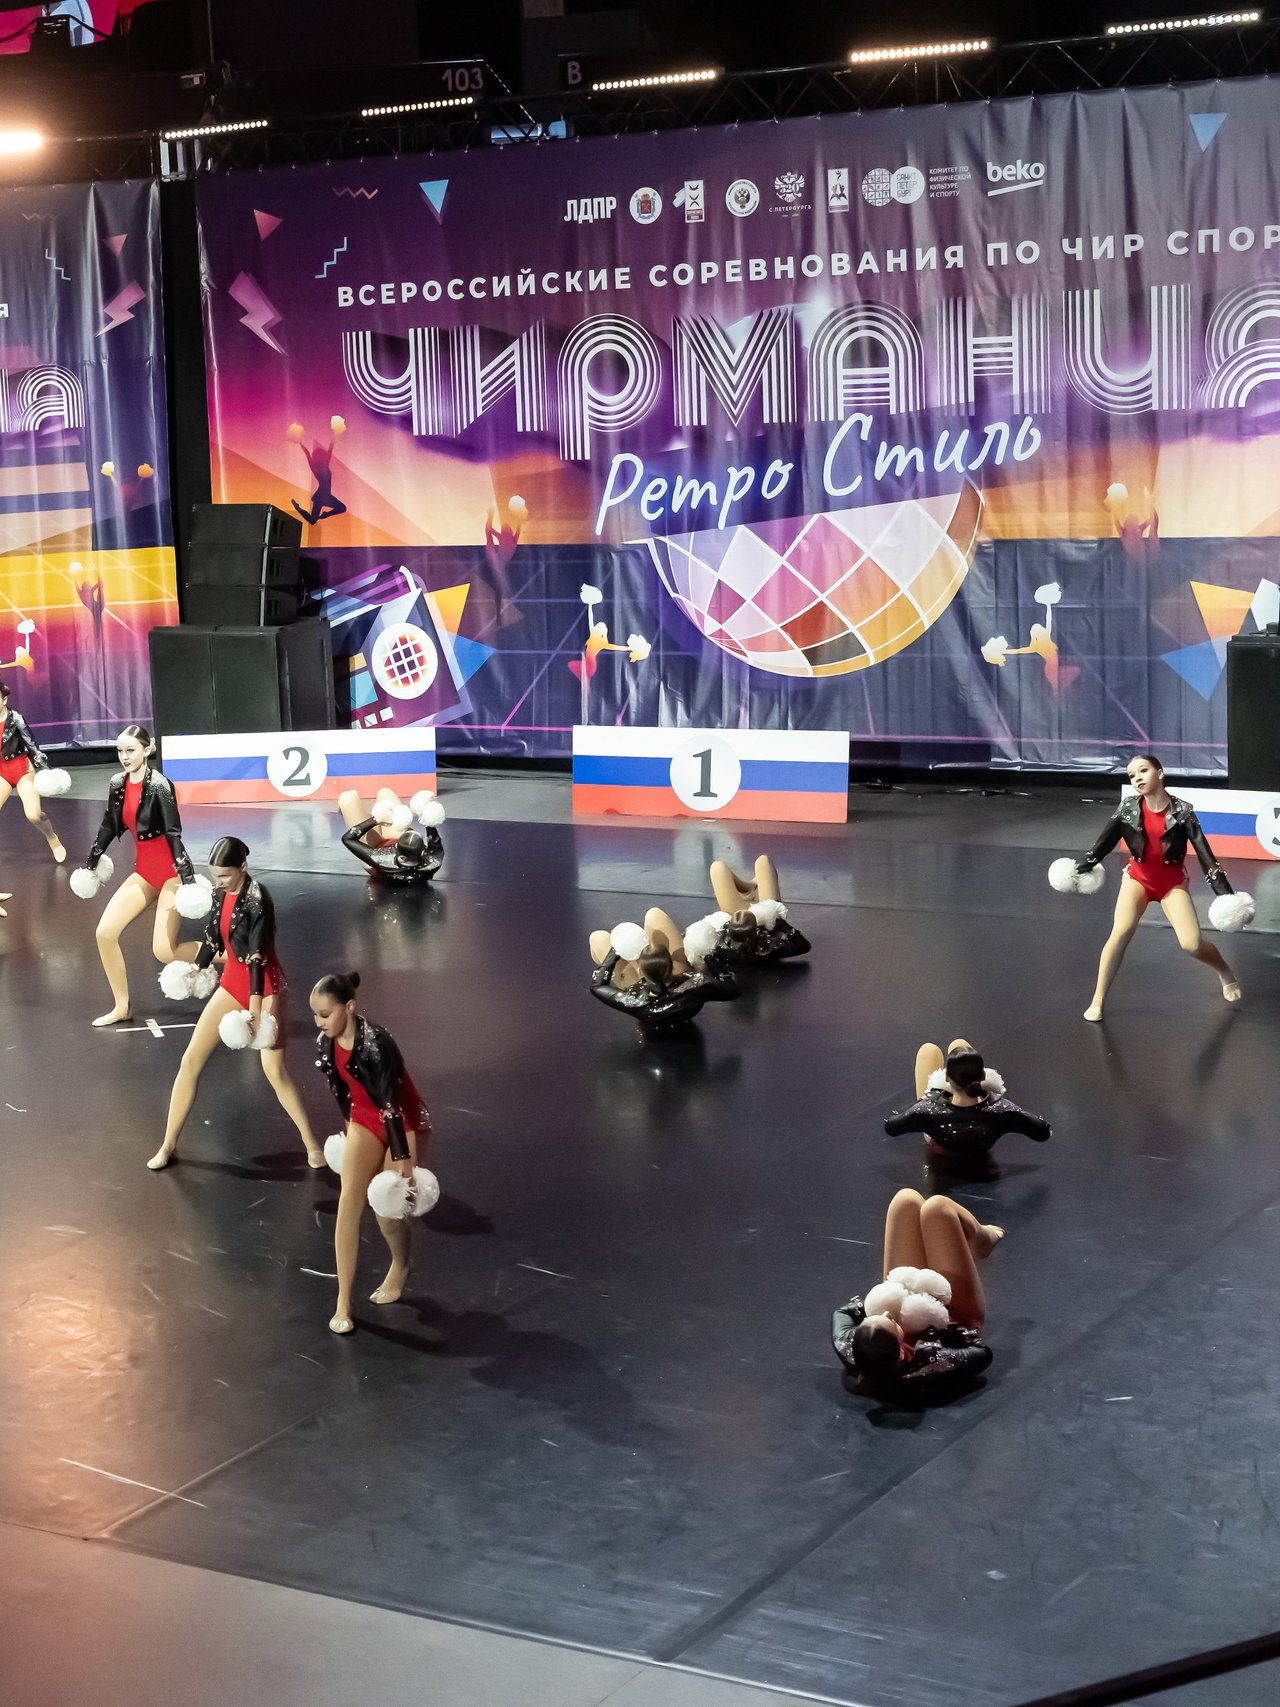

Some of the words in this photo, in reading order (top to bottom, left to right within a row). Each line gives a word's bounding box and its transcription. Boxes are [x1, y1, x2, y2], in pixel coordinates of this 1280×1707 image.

[441, 67, 484, 92] 103
[567, 61, 582, 85] B
[929, 167, 957, 175] КОМИТЕТ
[929, 173, 971, 182] ФИЗИЧЕСКОЙ
[987, 160, 1045, 182] beko
[564, 197, 617, 224] ЛДПР
[336, 263, 631, 308] ВСЕРОССИЙСКИЕ
[648, 245, 964, 288] СОРЕВНОВАНИЯ
[986, 240, 1040, 266] ПО
[1062, 234, 1145, 261] ЧИР
[595, 452, 795, 537] Ретро
[822, 412, 1042, 497] Стиль
[281, 745, 313, 788] 2
[693, 748, 719, 799] 1
